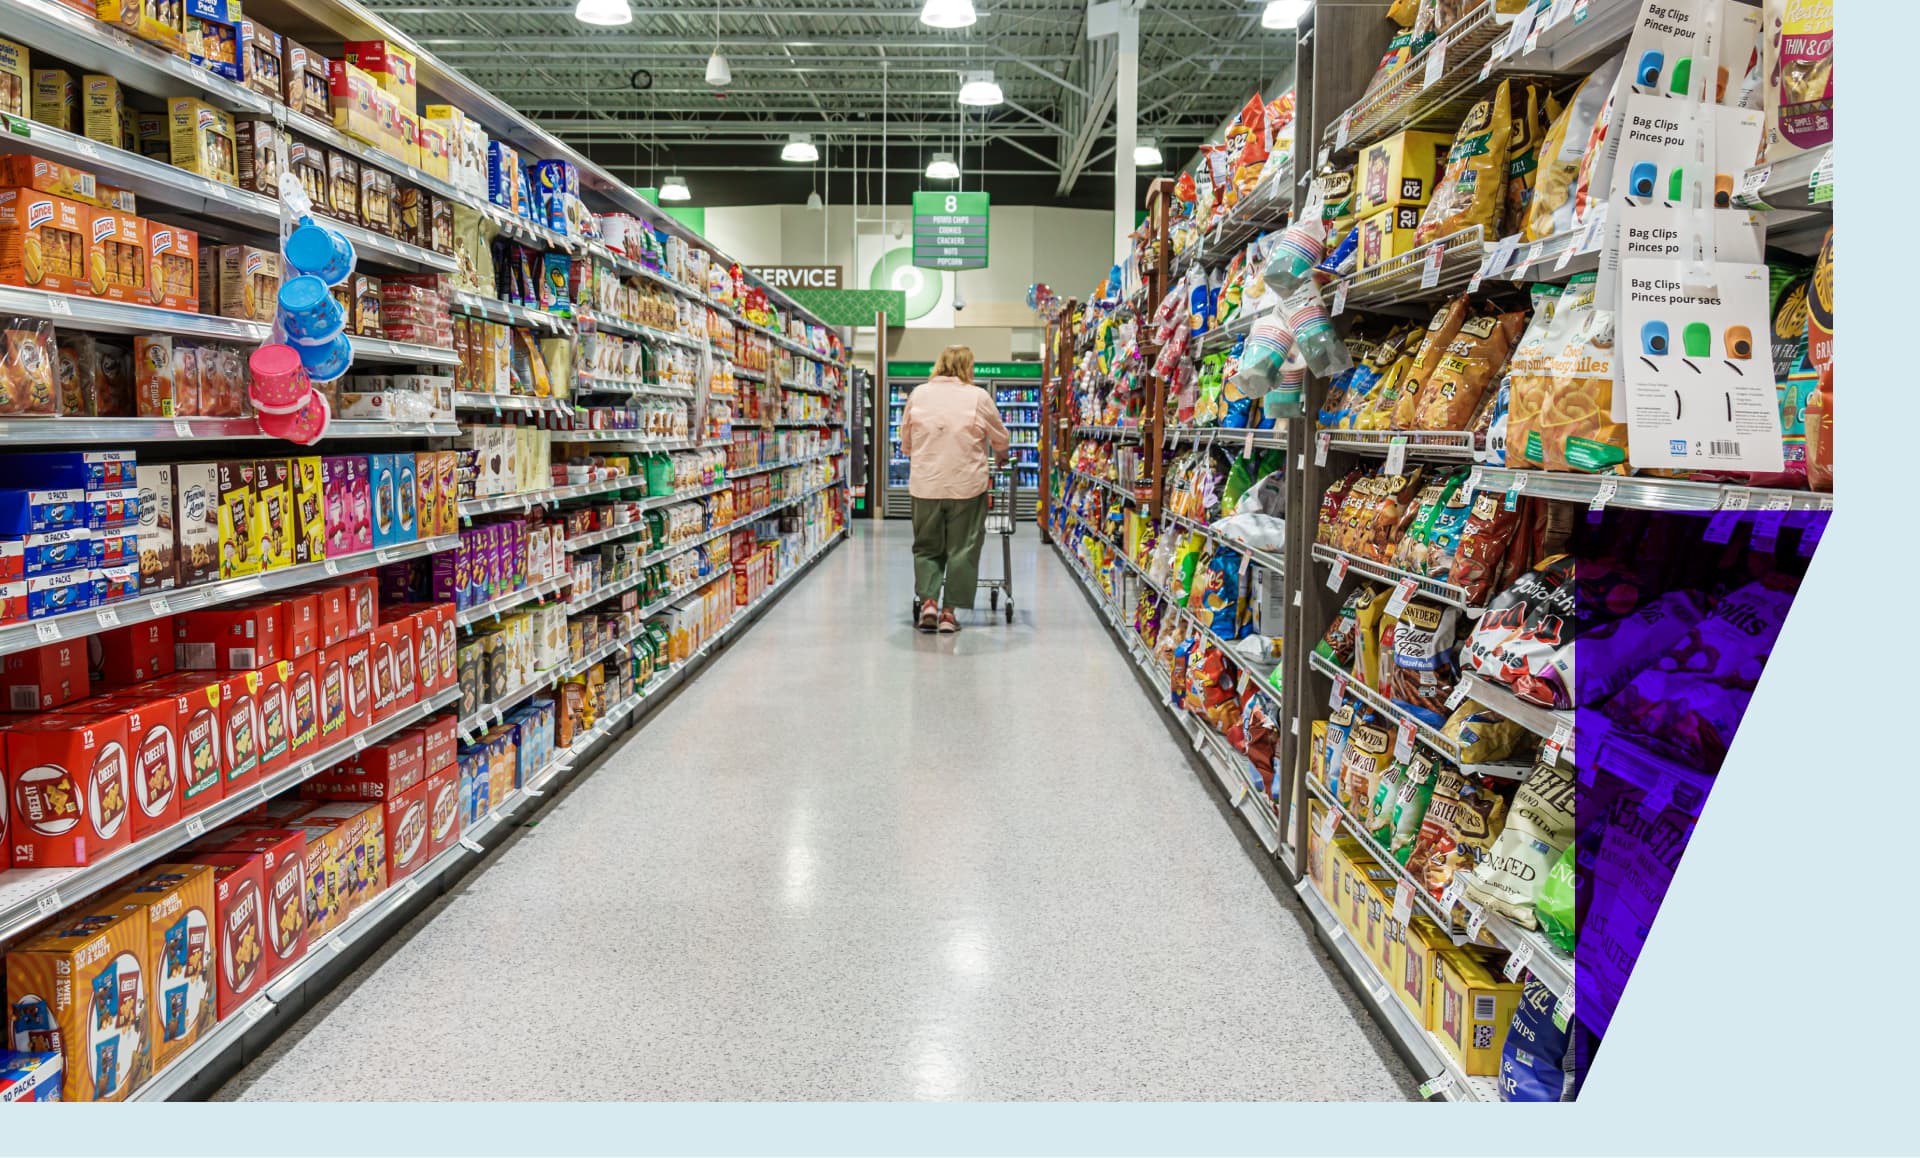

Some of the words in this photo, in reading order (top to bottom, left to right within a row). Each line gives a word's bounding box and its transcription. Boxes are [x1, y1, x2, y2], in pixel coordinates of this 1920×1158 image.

[1649, 4, 1664, 17] Bag
[1667, 8, 1689, 22] Clips
[1644, 18, 1673, 34] Pinces
[1673, 26, 1696, 40] pour
[1785, 39, 1805, 55] THIN
[1806, 39, 1816, 55] &
[1632, 116, 1651, 130] Bag
[1654, 120, 1678, 132] Clips
[1788, 124, 1795, 135] 4
[1630, 130, 1662, 144] Pinces
[1664, 134, 1685, 147] pou
[1403, 183, 1421, 197] 20
[945, 195, 957, 213] 8
[30, 205, 52, 221] Lance
[933, 216, 952, 224] POTATO
[953, 216, 969, 224] CHIPS
[1401, 210, 1412, 227] 20
[94, 220, 114, 236] Lance
[1629, 228, 1650, 241] Bag
[1652, 229, 1678, 239] Clips
[154, 233, 170, 249] Lance
[1628, 242, 1663, 253] Pinces
[1665, 244, 1680, 254] po
[937, 258, 963, 266] POPCORN
[751, 269, 837, 287] SERVICE
[1631, 279, 1652, 291] Bag
[1654, 279, 1681, 291] Clips
[1631, 293, 1667, 303] Pinces
[1669, 295, 1695, 305] pour
[1698, 296, 1721, 305] sacs
[1782, 345, 1799, 358] FREE
[160, 470, 168, 480] 10
[208, 468, 216, 479] 10
[220, 467, 230, 482] 12
[258, 465, 267, 480] 12
[53, 491, 68, 499] PACKS
[140, 492, 156, 505] amous
[50, 531, 71, 541] PACKS
[55, 575, 71, 584] PACKS
[1405, 607, 1438, 623] SNYDER'S
[150, 626, 159, 638] 12
[60, 648, 70, 661] 12
[1399, 642, 1425, 656] Free
[223, 684, 231, 694] 12
[179, 697, 188, 709] 12
[130, 713, 141, 728] 12
[83, 730, 94, 744] 12
[375, 783, 383, 797] 20
[1520, 808, 1558, 838] CHIPS
[16, 844, 28, 861] 12
[265, 852, 274, 862] 20
[219, 882, 228, 893] 20
[151, 903, 161, 917] 20
[162, 892, 178, 909] SWEET
[166, 898, 182, 915] SALTY
[75, 951, 85, 965] 20
[87, 936, 106, 954] SWEET
[92, 943, 111, 963] SALTY
[62, 960, 70, 974] 20
[1504, 1061, 1513, 1073] &
[14, 1075, 36, 1097] PACKS
